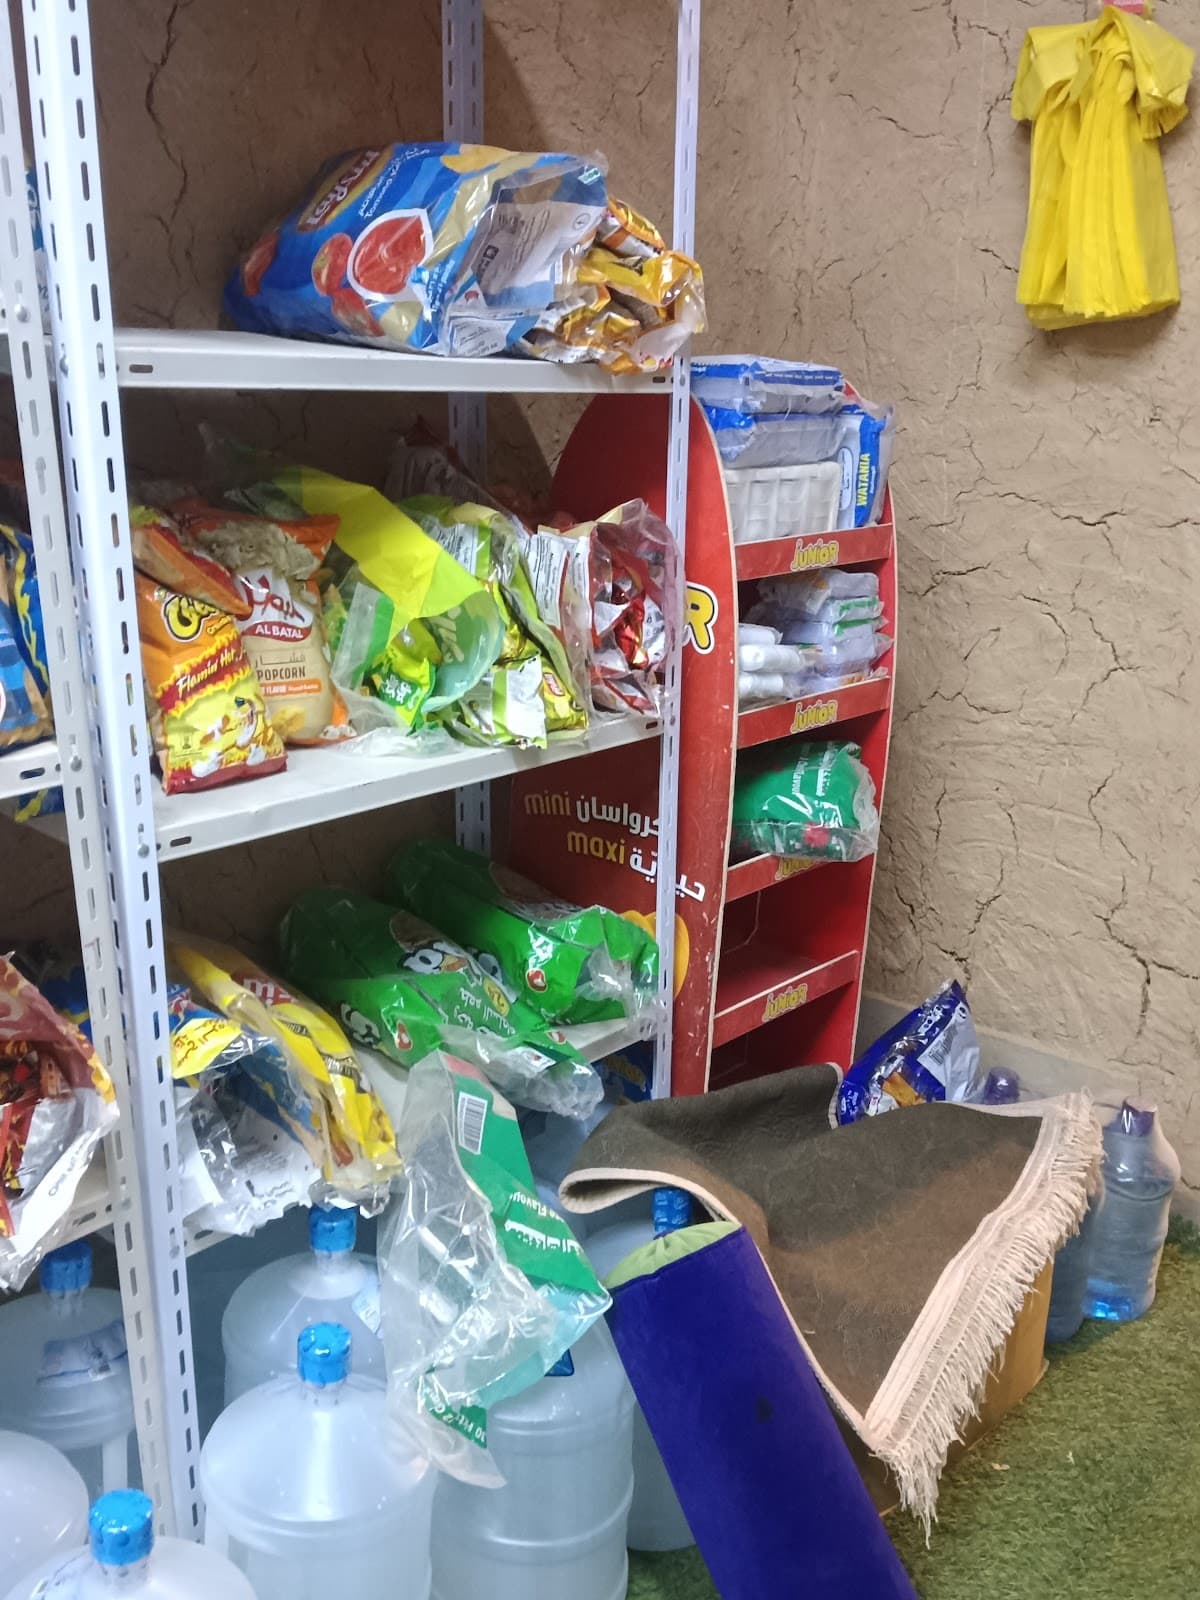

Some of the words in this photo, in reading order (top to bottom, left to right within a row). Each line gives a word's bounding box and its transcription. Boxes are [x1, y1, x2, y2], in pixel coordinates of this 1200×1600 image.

[856, 453, 870, 506] WATANIA
[791, 539, 839, 571] JUNIOR
[272, 626, 304, 639] BATAL
[256, 665, 306, 681] POPCORN
[791, 700, 838, 733] JUNIOR
[524, 791, 571, 817] mini
[567, 831, 625, 865] maxi
[761, 983, 808, 1023] JUNIOR
